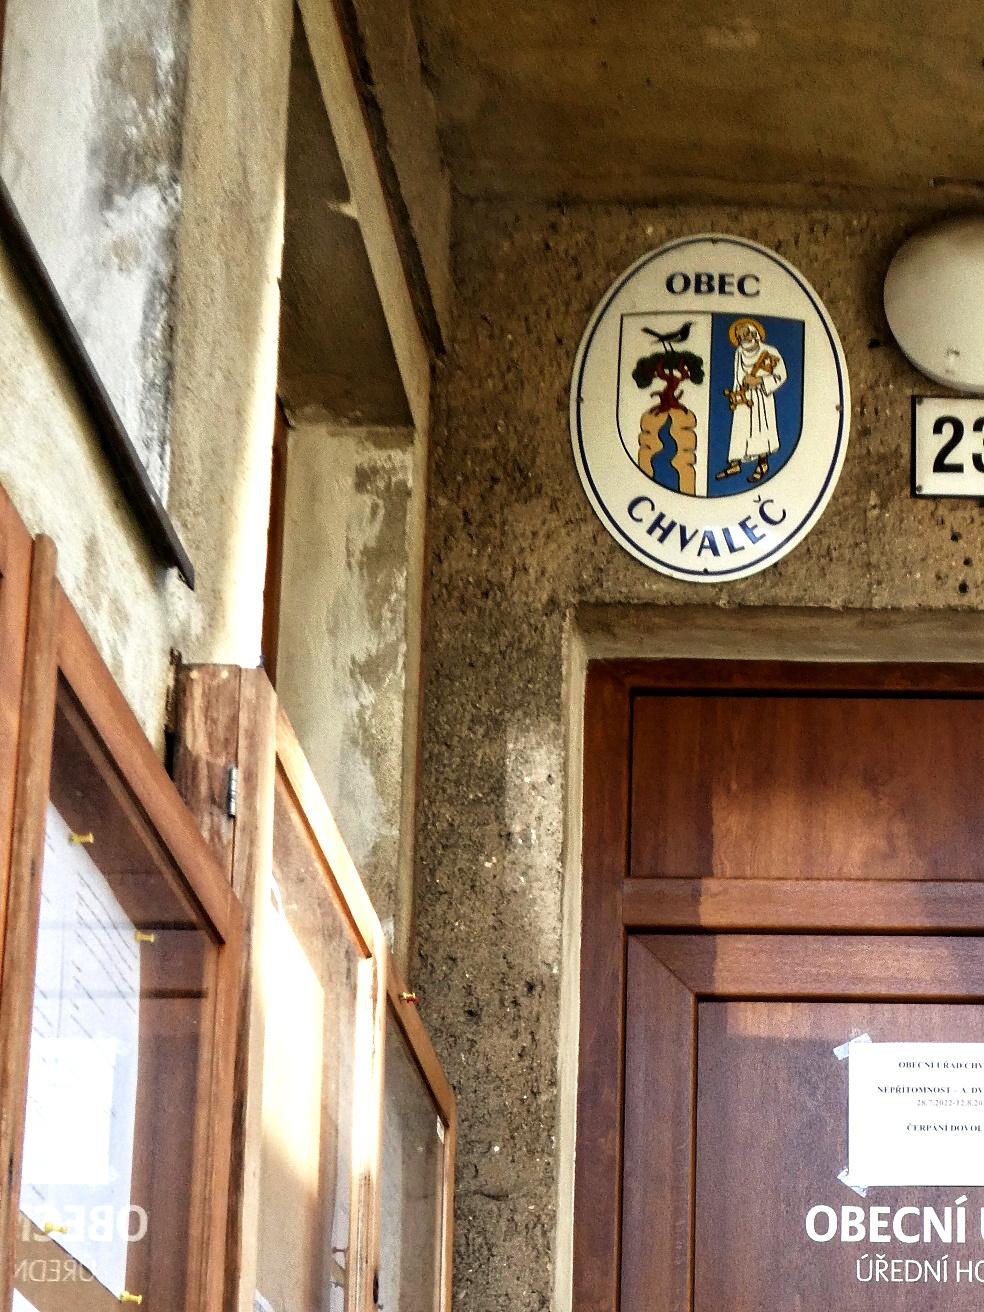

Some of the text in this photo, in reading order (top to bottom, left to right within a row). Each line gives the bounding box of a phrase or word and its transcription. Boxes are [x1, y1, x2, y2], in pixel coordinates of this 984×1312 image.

[665, 271, 761, 298] OBEC
[627, 494, 787, 557] CHVALEČ
[805, 1194, 969, 1244] OBECNÍ
[856, 1252, 949, 1283] ÚŘEDNÍ
